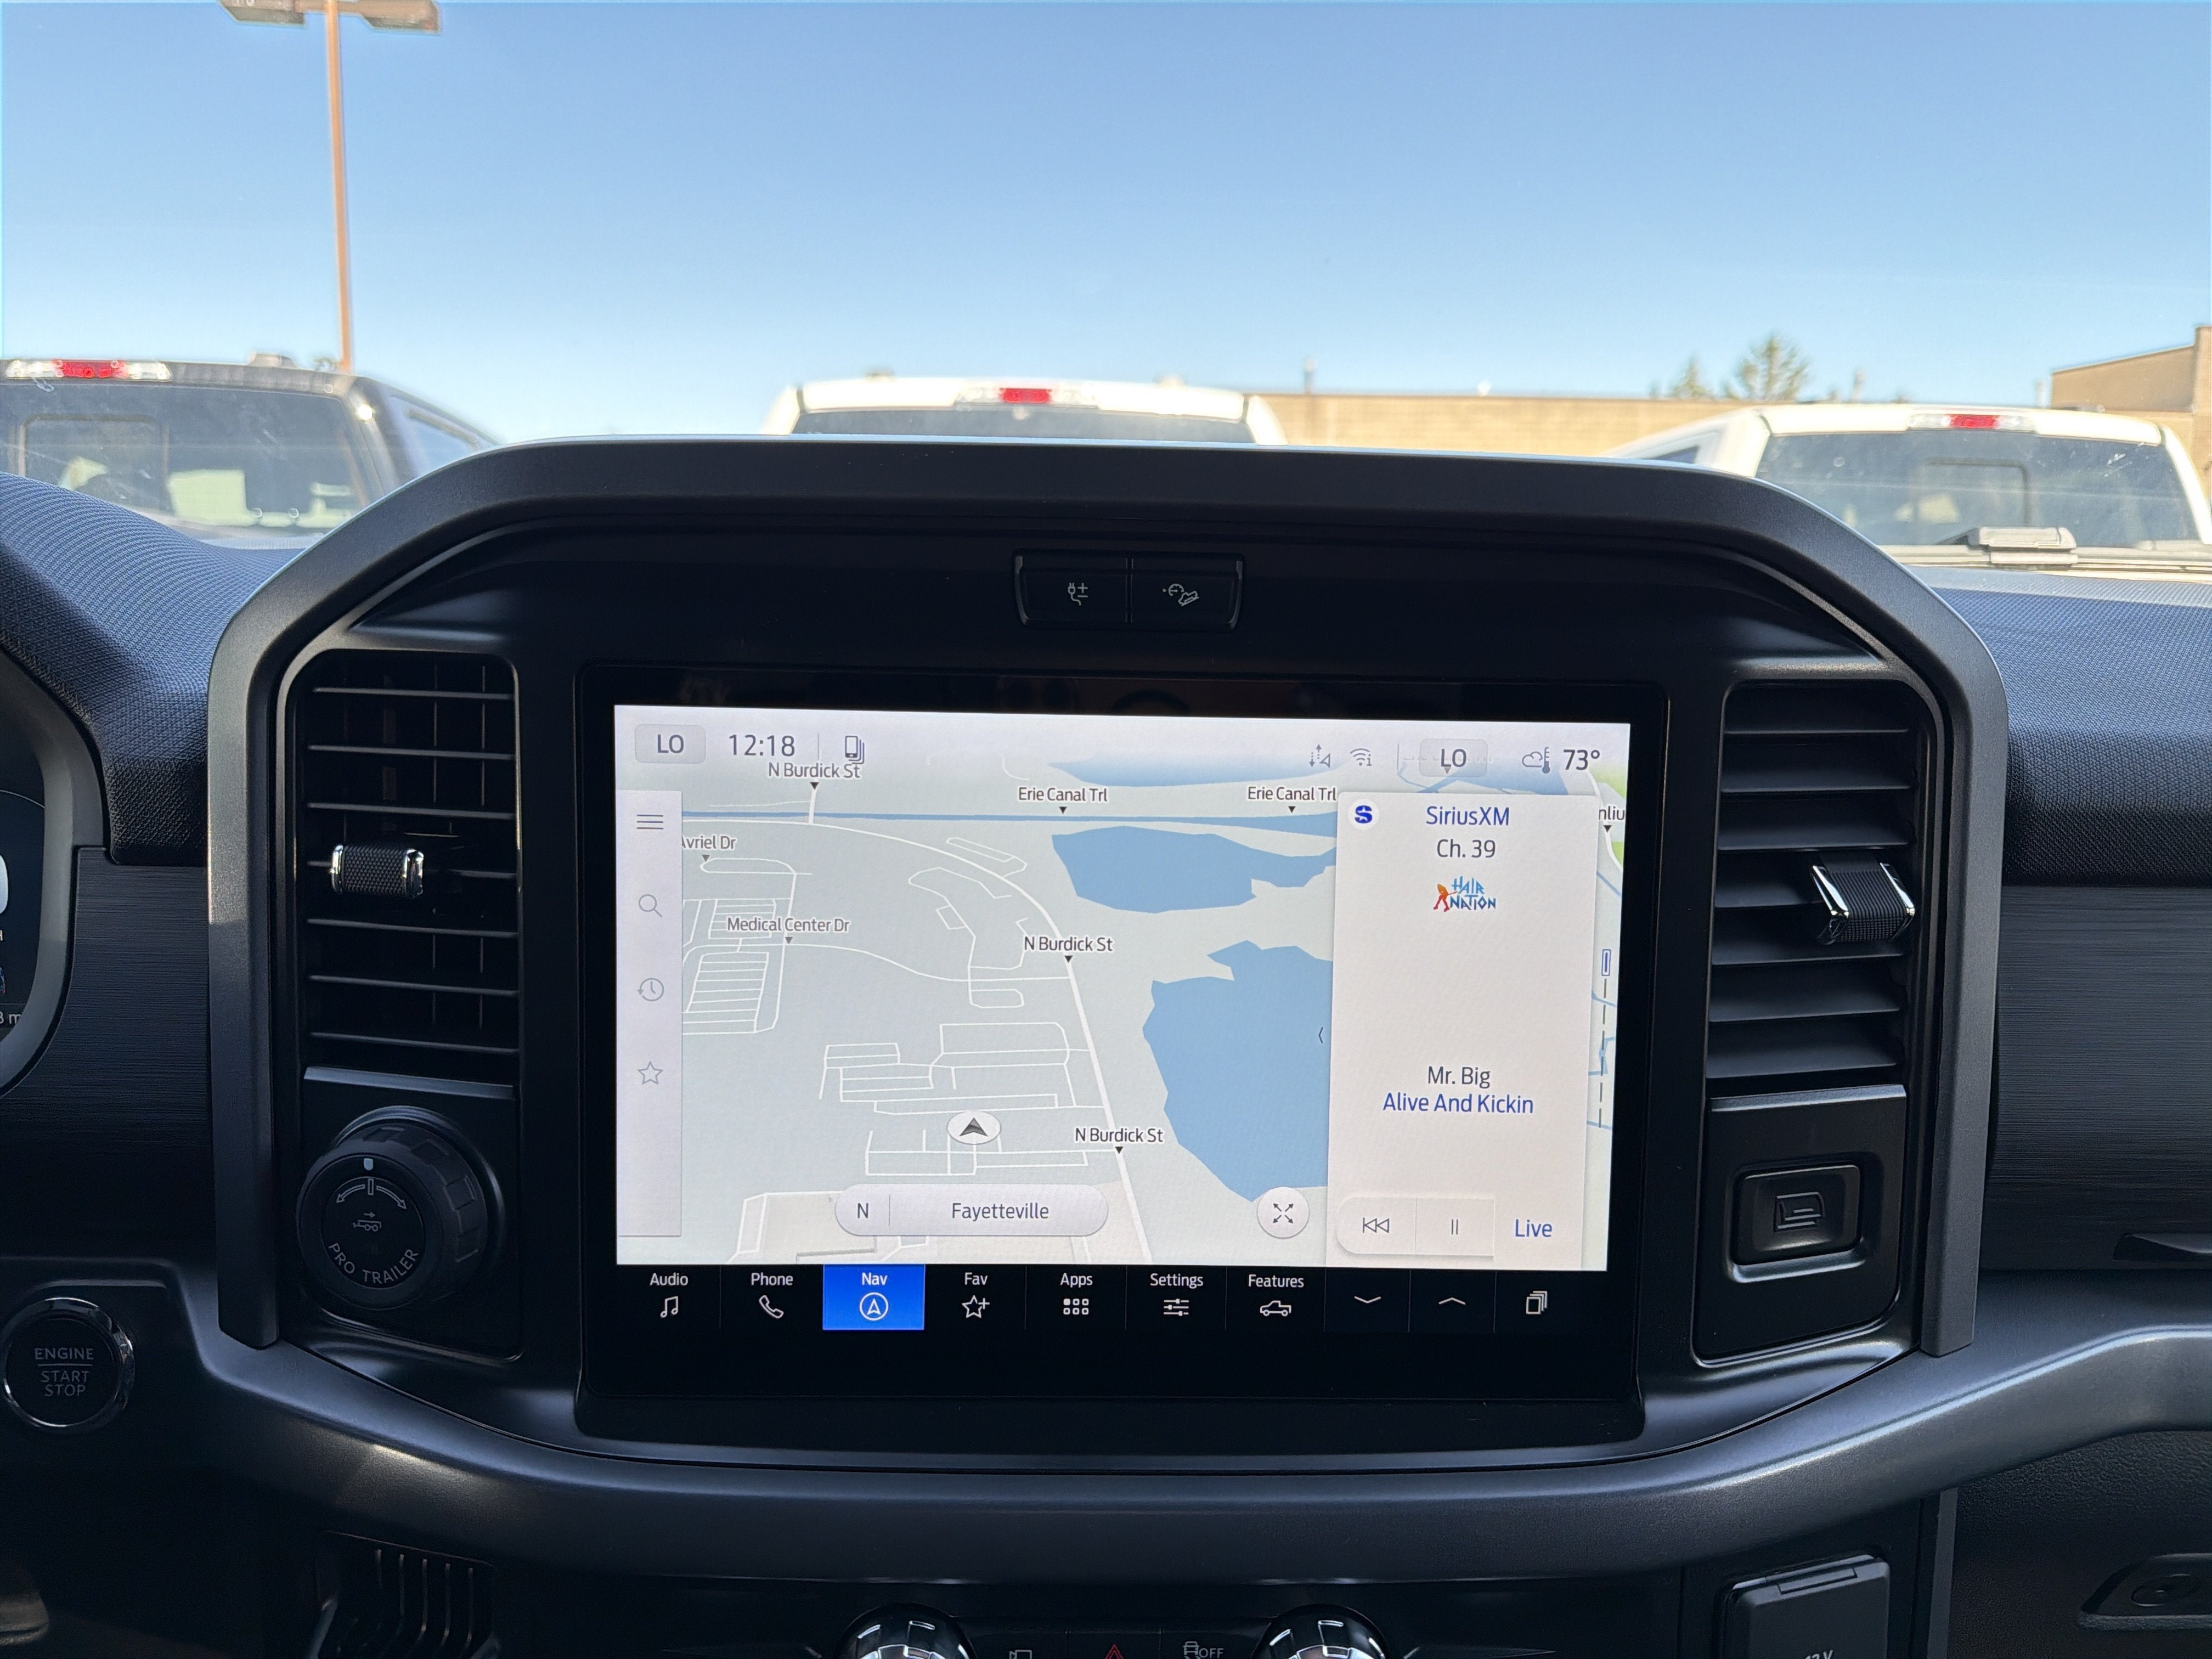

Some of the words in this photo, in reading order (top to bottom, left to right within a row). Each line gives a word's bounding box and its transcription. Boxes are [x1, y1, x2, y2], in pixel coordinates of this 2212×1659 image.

[657, 735, 684, 753] LO
[729, 735, 795, 757] 12:18
[1441, 748, 1467, 768] LO
[1564, 749, 1600, 771] 73°
[769, 763, 780, 777] N
[784, 763, 840, 778] Burdick
[844, 764, 861, 778] St
[1018, 787, 1044, 802] Erie
[1047, 787, 1086, 802] Canal
[1089, 788, 1108, 802] Trl
[1248, 786, 1273, 800] Erie
[1276, 786, 1314, 801] Canal
[1318, 787, 1336, 801] Trl
[1426, 806, 1510, 826] SiriusXM
[720, 836, 736, 849] Dr
[1437, 839, 1466, 858] Ch.
[1471, 840, 1496, 858] 39
[1451, 876, 1485, 894] HAIR
[1450, 894, 1496, 910] NATION
[727, 917, 782, 932] Medical
[785, 918, 831, 932] Center
[834, 918, 850, 933] Dr
[1025, 936, 1035, 951] N
[1039, 936, 1093, 952] Burdick
[1096, 938, 1113, 952] St
[1427, 1066, 1456, 1085] Mr.
[1462, 1066, 1491, 1089] Big
[1383, 1092, 1429, 1112] Alive
[1434, 1093, 1472, 1113] And
[1478, 1094, 1534, 1114] Kickin
[1075, 1128, 1086, 1142] N
[1091, 1128, 1143, 1142] Burdick
[1147, 1129, 1163, 1142] St
[857, 1203, 869, 1218] N
[952, 1202, 1049, 1222] Fayetteville
[1515, 1218, 1553, 1238] Live
[328, 1242, 356, 1274] PRO
[362, 1249, 419, 1284] TRAILER
[650, 1272, 689, 1286] Audio
[751, 1272, 793, 1286] Phone
[861, 1273, 888, 1285] Nav
[964, 1272, 988, 1286] Fav
[1060, 1273, 1093, 1289] Apps
[1150, 1273, 1204, 1289] Settings
[1248, 1274, 1304, 1288] Features
[34, 1347, 94, 1360] ENGINE
[40, 1370, 89, 1383] START
[44, 1384, 86, 1397] STOP
[1199, 1647, 1224, 1658] OFF
